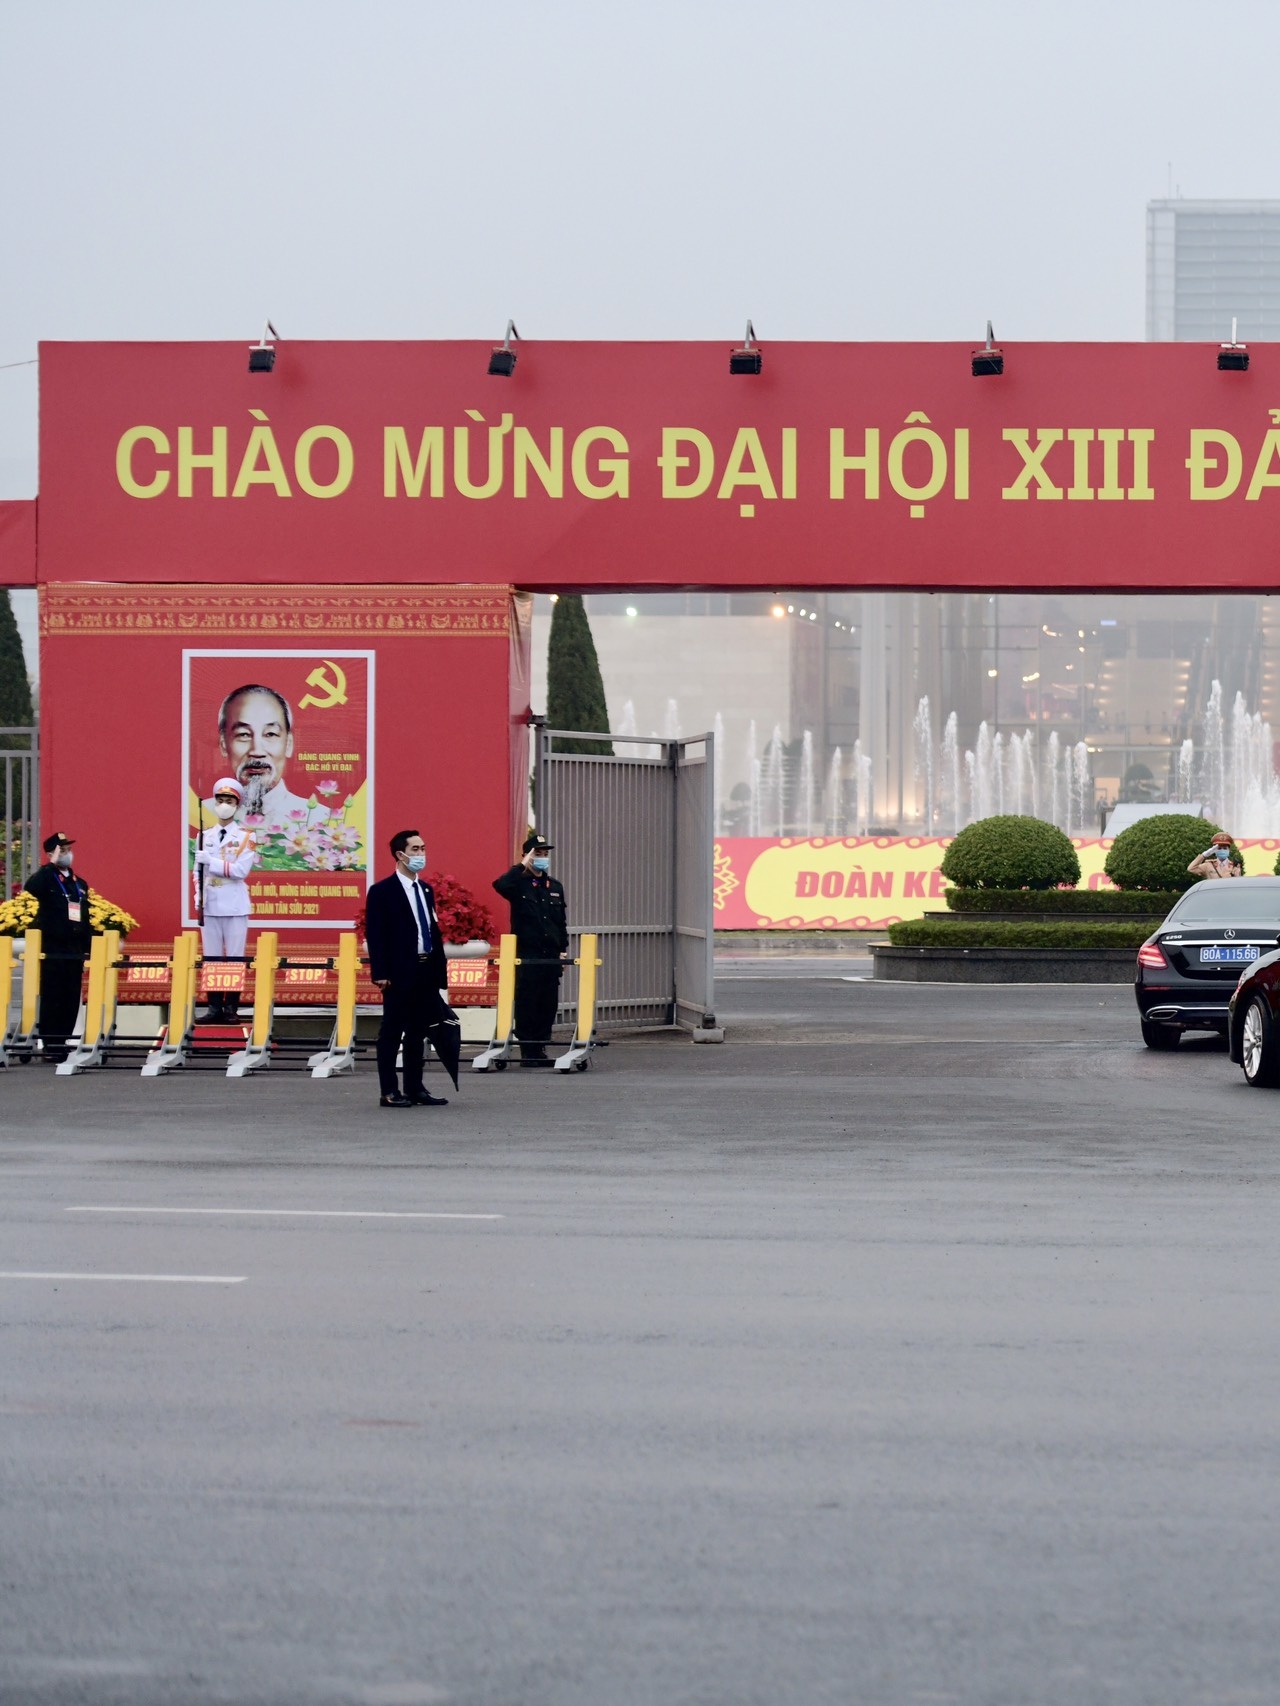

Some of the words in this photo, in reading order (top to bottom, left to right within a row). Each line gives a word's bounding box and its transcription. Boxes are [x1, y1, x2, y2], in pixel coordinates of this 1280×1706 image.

[116, 409, 354, 499] CHÀO
[384, 410, 629, 500] MỪNG
[657, 428, 796, 518] ĐẠI
[830, 411, 969, 519] HỘI
[1002, 429, 1154, 501] XIII
[319, 753, 342, 762] QUANG
[343, 753, 359, 761] VINH
[795, 865, 894, 899] ĐOÀN
[319, 885, 341, 898] QUANG
[303, 903, 319, 915] 2021
[1203, 948, 1257, 960] 80A-115.66
[133, 967, 164, 979] STOP
[290, 968, 322, 981] STOP
[450, 971, 483, 983] STOP
[207, 974, 240, 987] STOP
